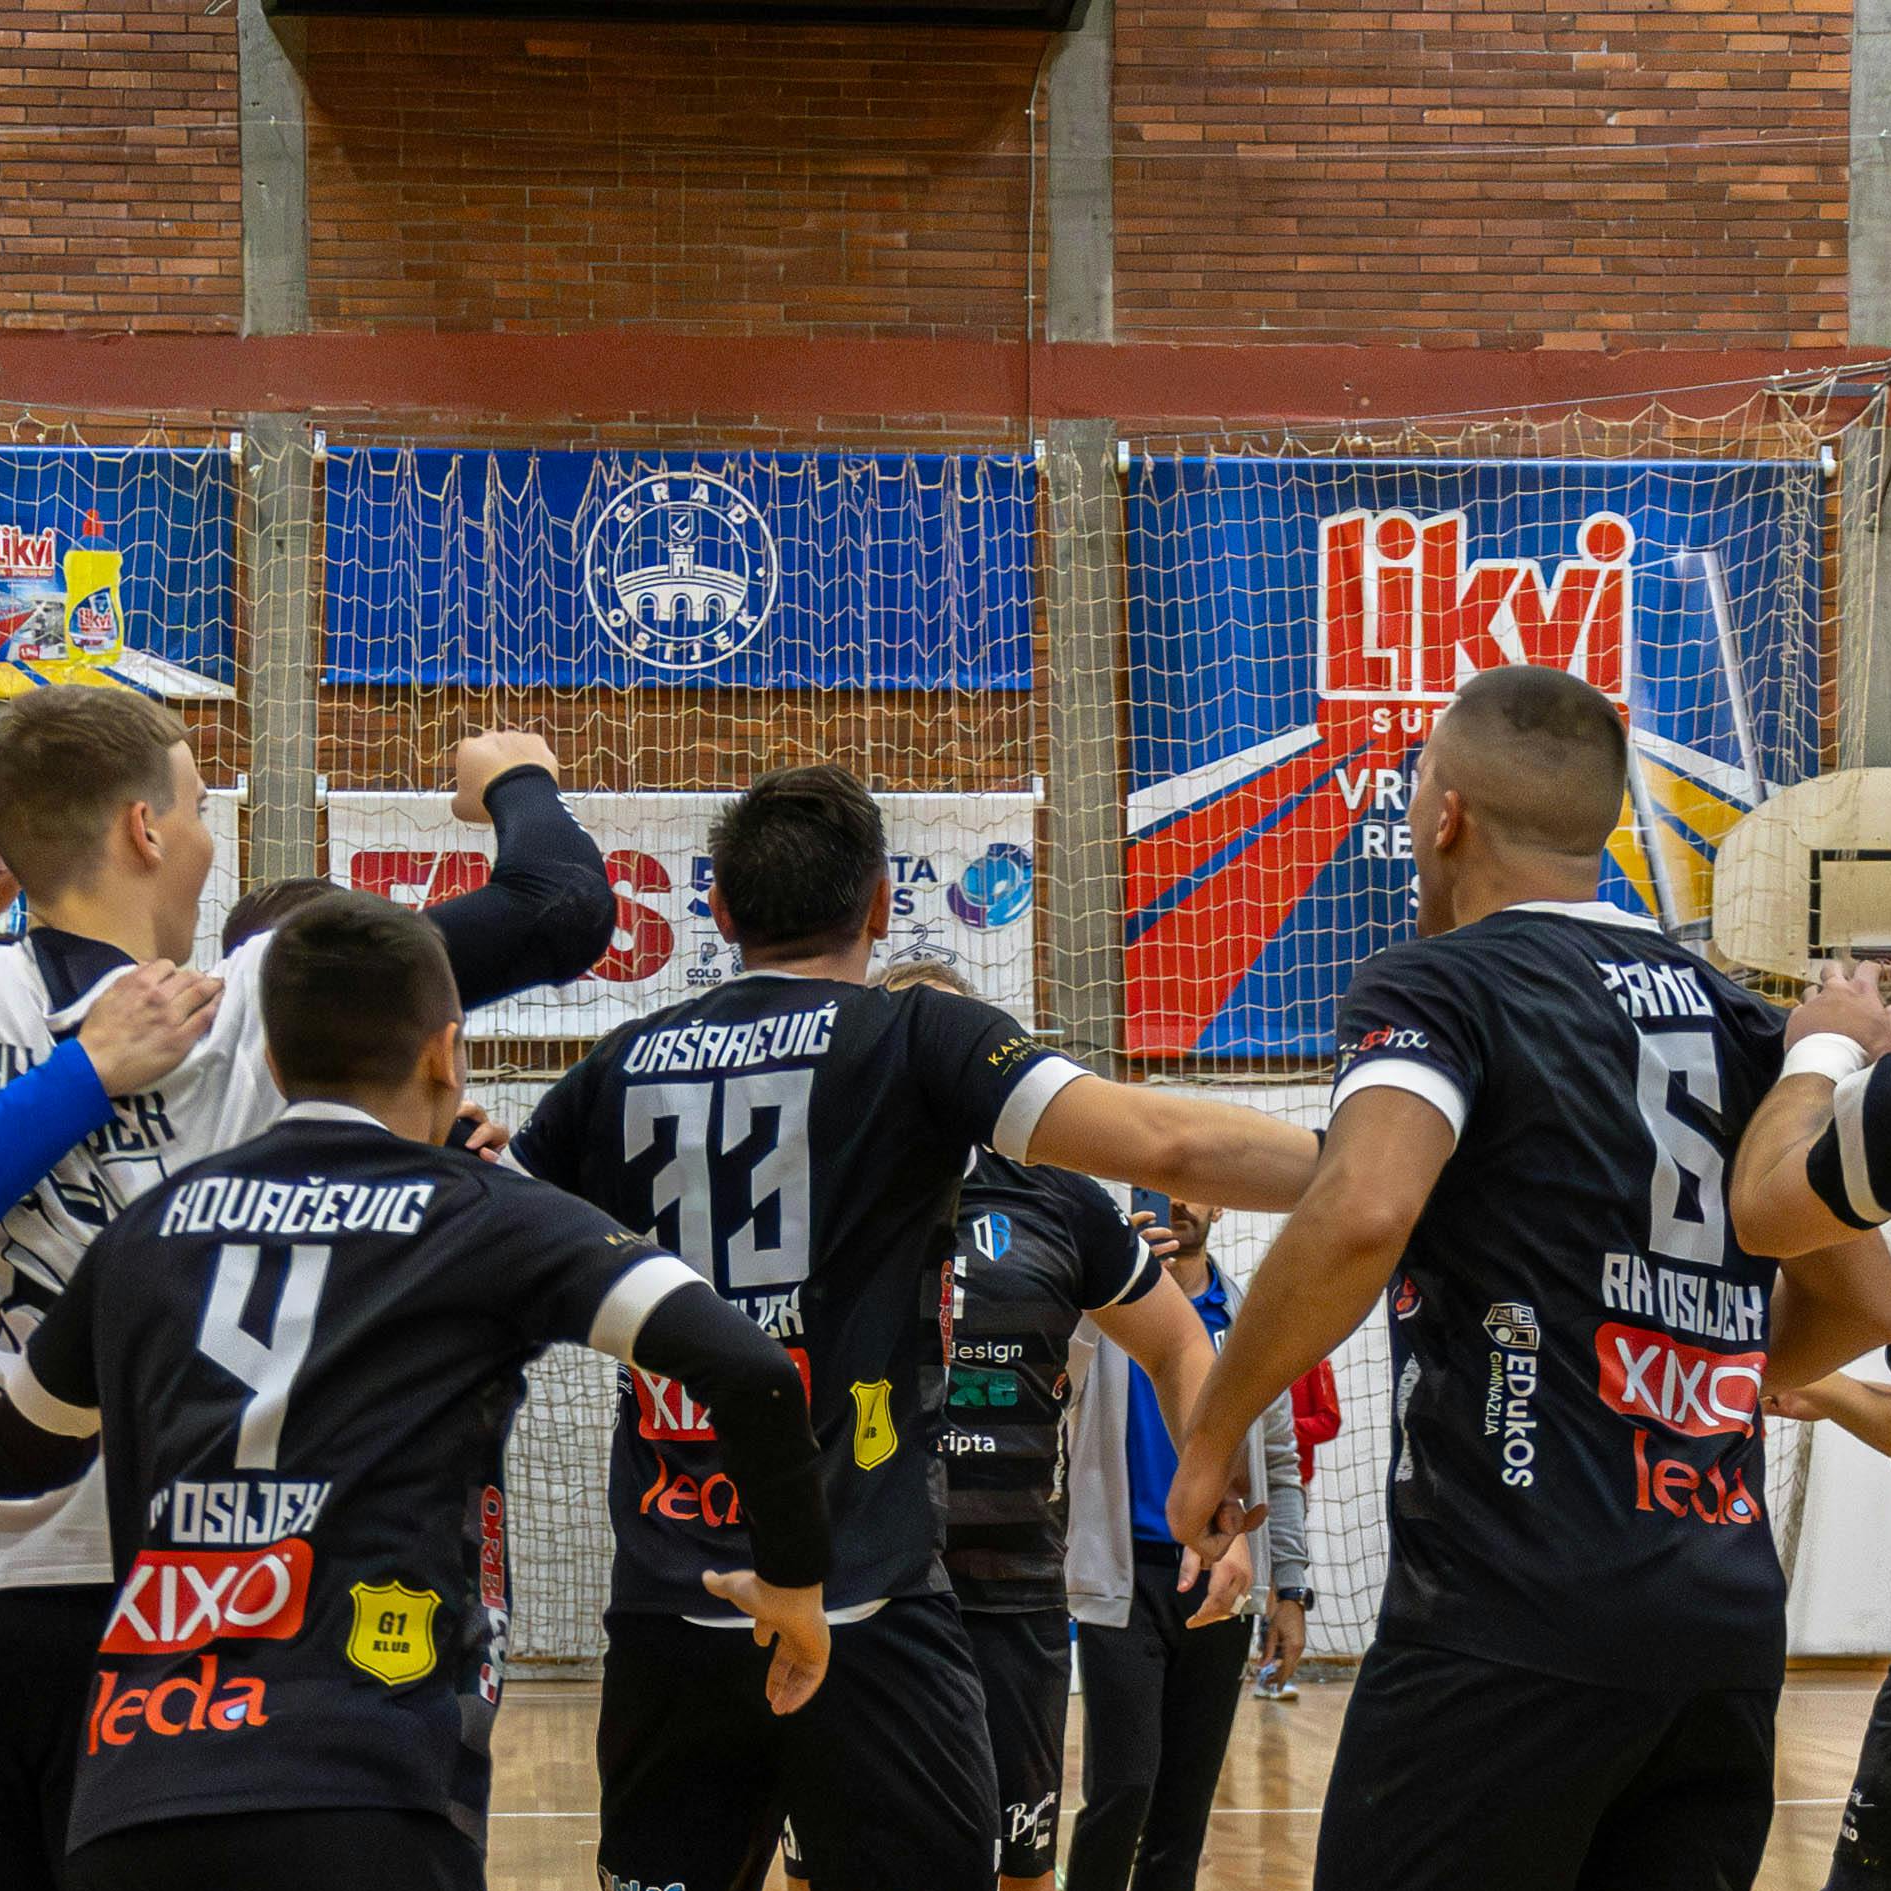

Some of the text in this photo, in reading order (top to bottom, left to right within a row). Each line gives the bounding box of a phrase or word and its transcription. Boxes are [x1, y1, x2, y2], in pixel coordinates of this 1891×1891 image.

[615, 481, 749, 525] GRAD
[607, 607, 759, 662] OSIJEK
[1321, 511, 1633, 698] Likvi
[686, 968, 722, 978] COLD
[622, 1001, 840, 1075] VAŠAREVIĆ
[623, 1068, 814, 1289] 33
[1637, 1031, 1726, 1267] 6
[1603, 1252, 1763, 1343] RK OSIJEK
[196, 1243, 333, 1470] 4
[1483, 1351, 1502, 1437] GIMNAZIJA
[1614, 1337, 1762, 1427] XIXO
[171, 1480, 334, 1545] OSIJEK
[373, 1640, 411, 1654] KLUB
[378, 1611, 408, 1637] G1
